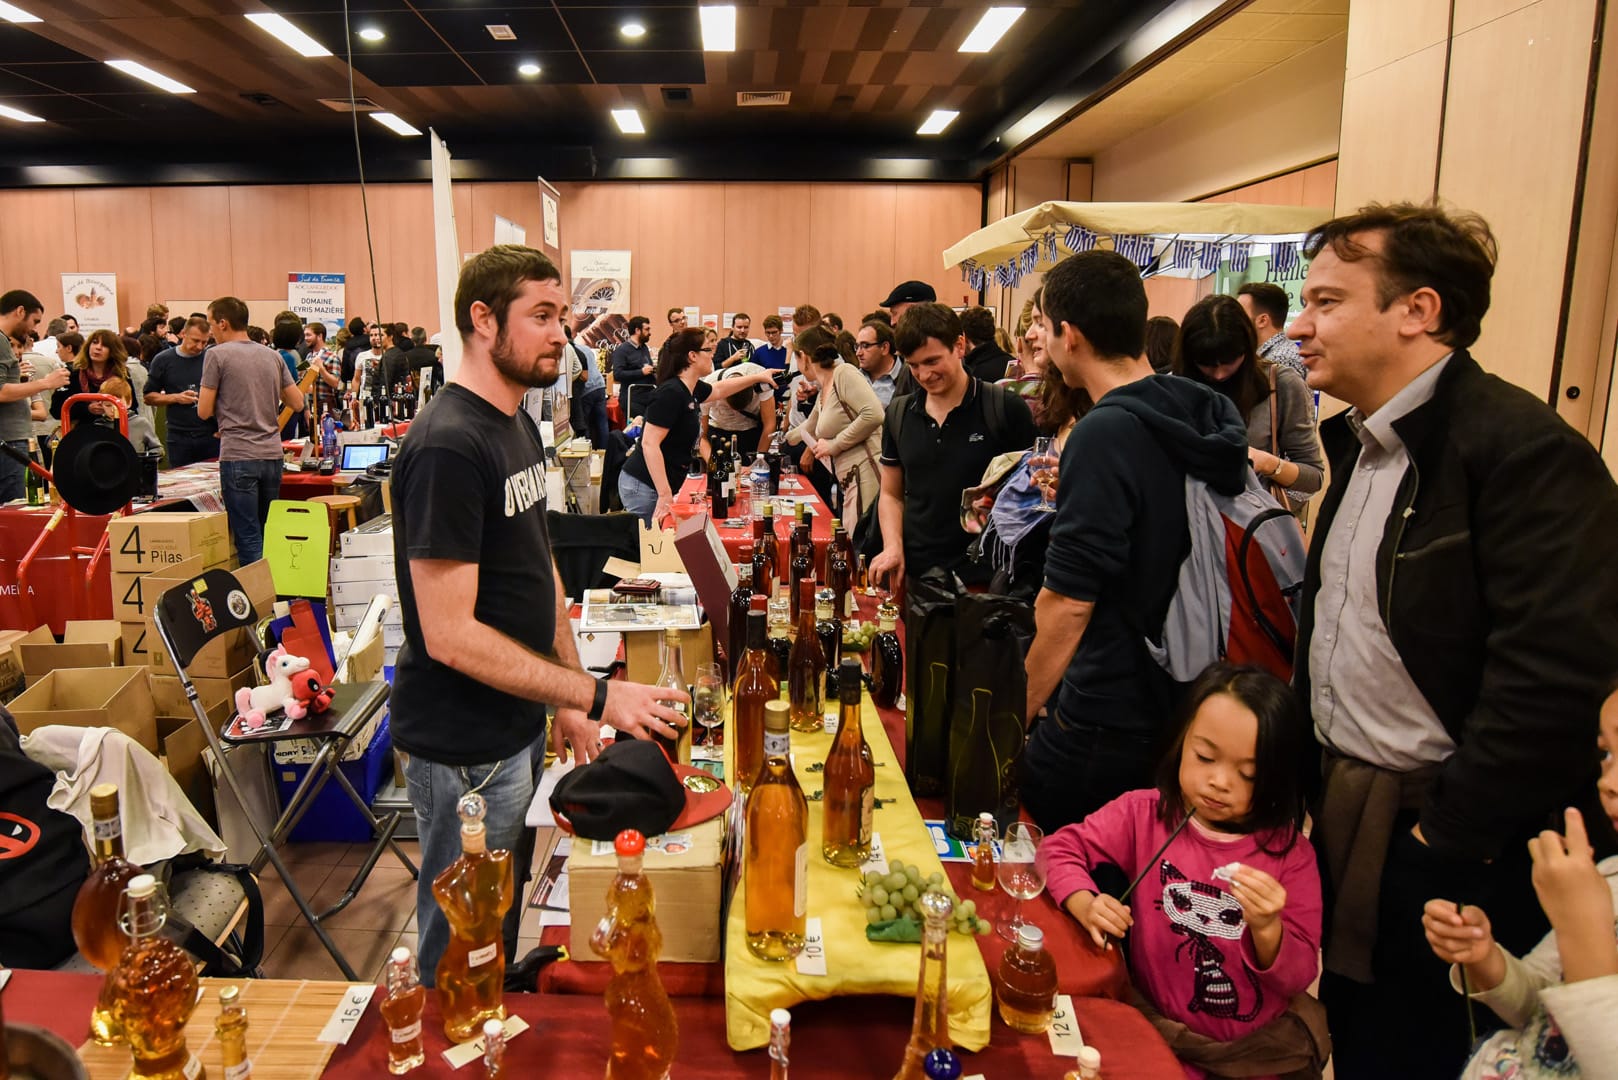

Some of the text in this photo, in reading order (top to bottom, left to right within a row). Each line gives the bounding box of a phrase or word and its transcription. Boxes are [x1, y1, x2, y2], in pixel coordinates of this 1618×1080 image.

[300, 297, 333, 305] DOMAINE
[314, 306, 345, 314] MAZIÈRE
[120, 525, 145, 564] 4
[151, 550, 183, 563] Pilas
